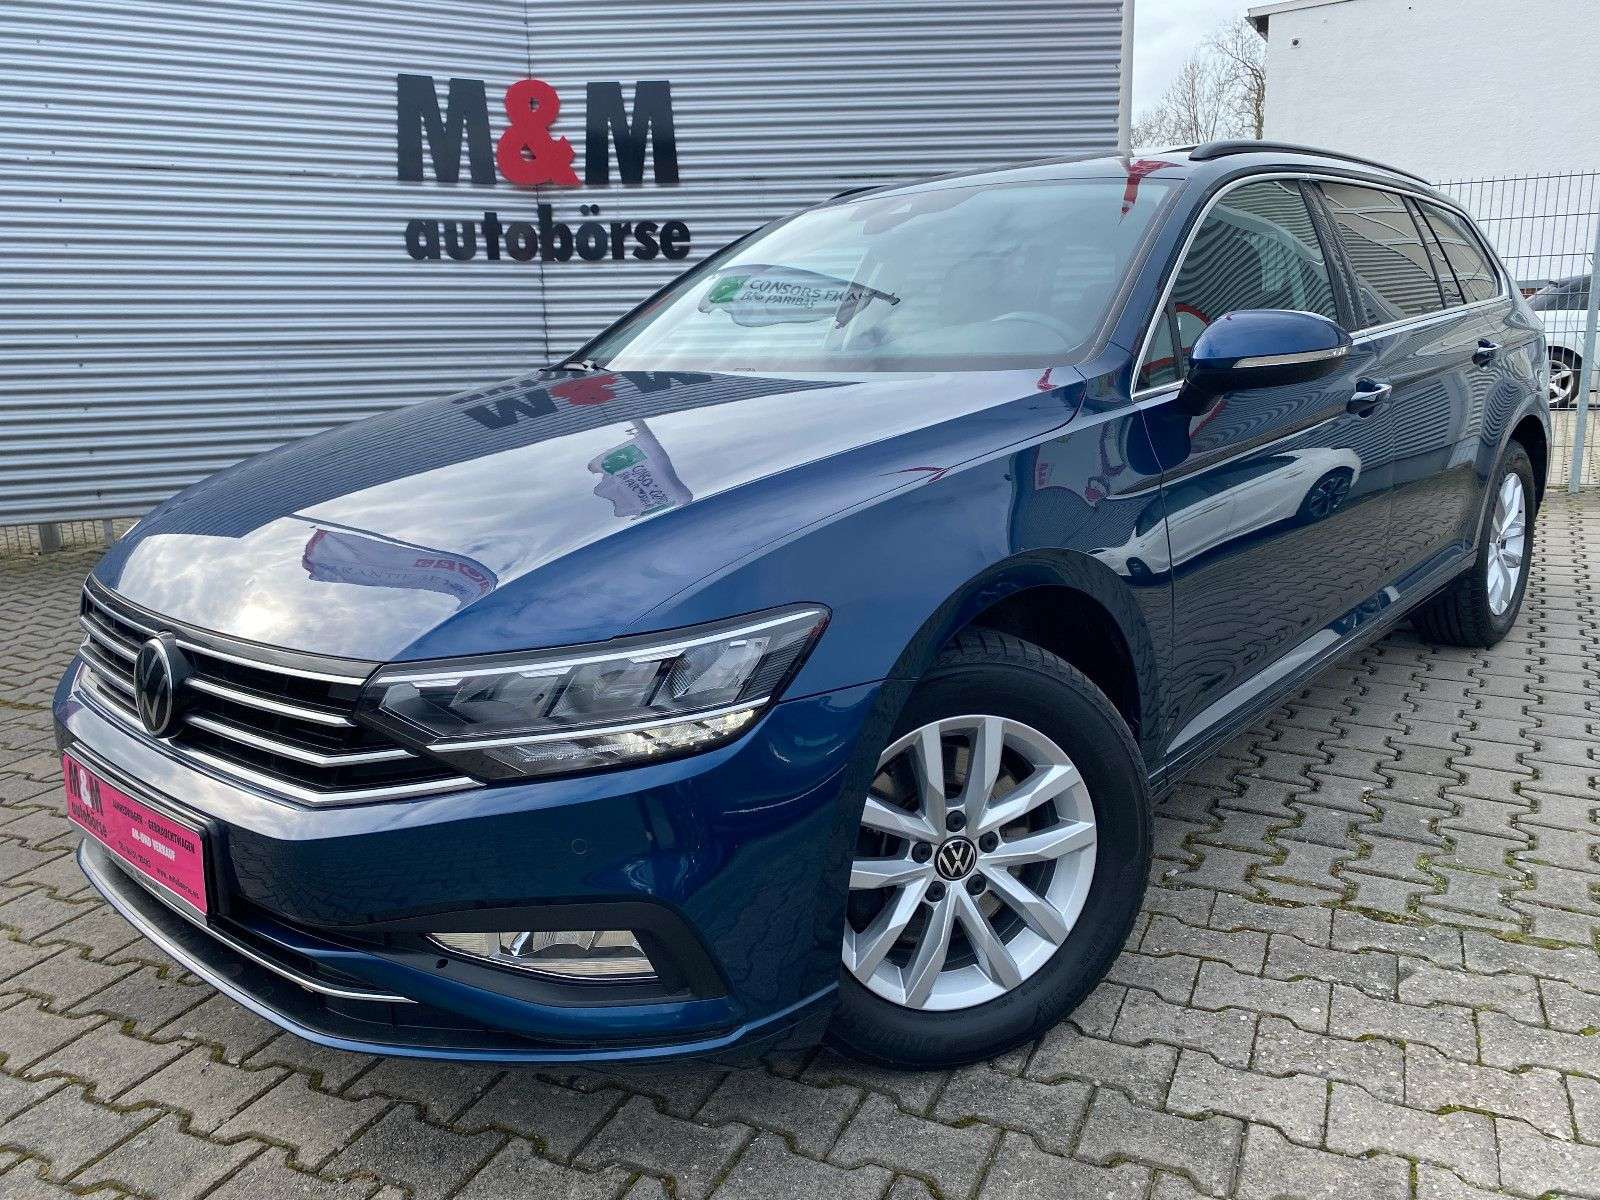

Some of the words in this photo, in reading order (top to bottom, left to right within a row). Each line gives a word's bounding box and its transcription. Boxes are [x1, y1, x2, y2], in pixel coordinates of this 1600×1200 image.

[397, 74, 679, 186] M&M
[406, 204, 691, 261] autobörse
[937, 840, 975, 879] VW
